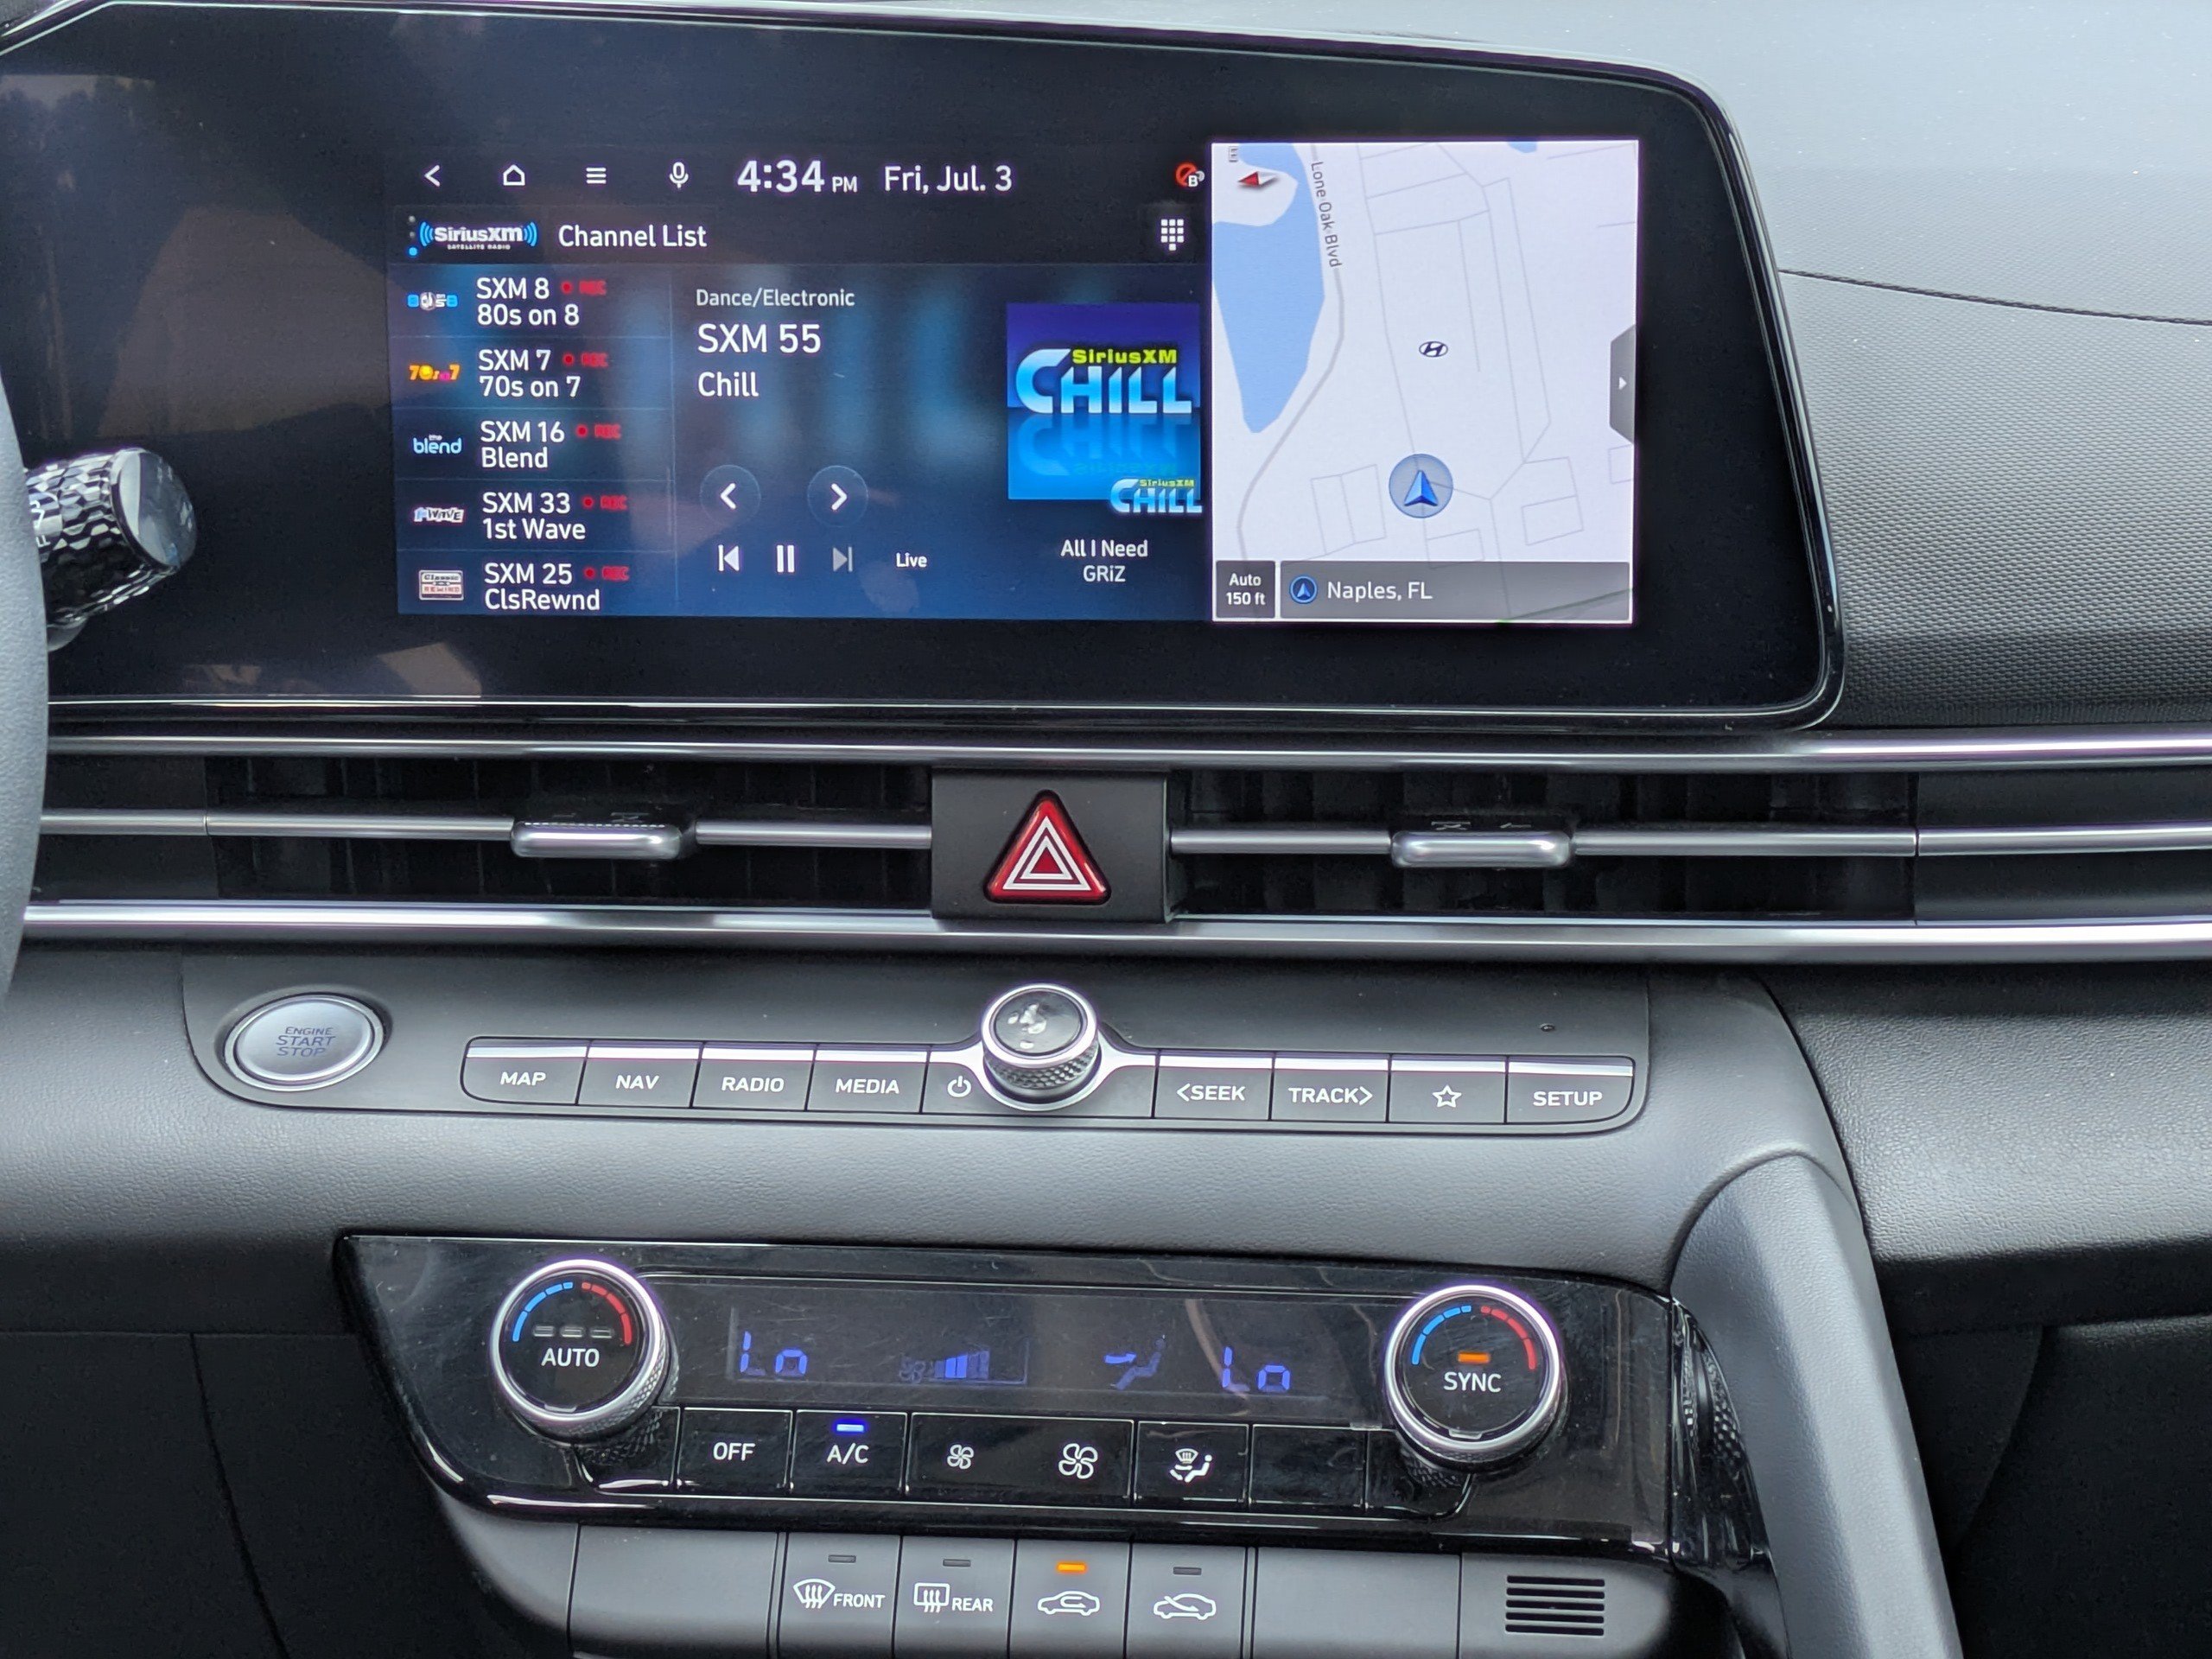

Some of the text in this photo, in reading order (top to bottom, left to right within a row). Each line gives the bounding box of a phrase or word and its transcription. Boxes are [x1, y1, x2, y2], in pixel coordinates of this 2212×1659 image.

[737, 160, 858, 193] 4:34 PM
[884, 165, 1013, 194] Fri, Jul. 3
[1310, 161, 1343, 268] Lone Oak Blvd
[558, 224, 708, 247] Channel List
[476, 277, 527, 300] SXM
[534, 277, 550, 299] 8
[696, 288, 855, 308] Dance/Electronic
[477, 303, 580, 326] 80s on 8
[697, 323, 822, 353] SXM 55
[479, 349, 529, 372] SXM
[536, 349, 551, 371] 7
[1071, 349, 1177, 364] SiriusXM
[480, 376, 581, 397] 70s on 7
[698, 372, 760, 397] Chill
[1015, 348, 1192, 414] CHILL
[480, 421, 531, 443] SXM
[537, 421, 565, 443] 16
[413, 437, 462, 454] blend
[481, 447, 549, 468] Blend
[482, 493, 532, 514] SXM
[539, 493, 570, 514] 33
[483, 519, 586, 540] 1st Wave
[1060, 540, 1148, 557] All I Need
[896, 553, 927, 568] Live
[484, 563, 535, 585] SXM
[542, 563, 573, 585] 25
[1229, 573, 1262, 587] Auto
[484, 589, 601, 611] ClsRewnd
[1226, 592, 1266, 606] 150 ft
[1327, 582, 1433, 602] Naples, FL
[276, 1036, 337, 1046] START
[285, 1027, 334, 1036] ENGINE
[276, 1047, 326, 1057] STOP
[499, 1071, 547, 1086] MAP
[615, 1075, 660, 1090] NAV
[721, 1077, 785, 1092] RADIO
[835, 1078, 900, 1095] MEDIA
[1532, 1090, 1603, 1107] SETUP
[541, 1348, 600, 1367] AUTO
[1443, 1371, 1502, 1393] SYNC
[713, 1442, 756, 1461] OFF
[827, 1444, 869, 1465] A/C
[833, 1592, 886, 1609] FRONT
[951, 1597, 994, 1613] REAR
